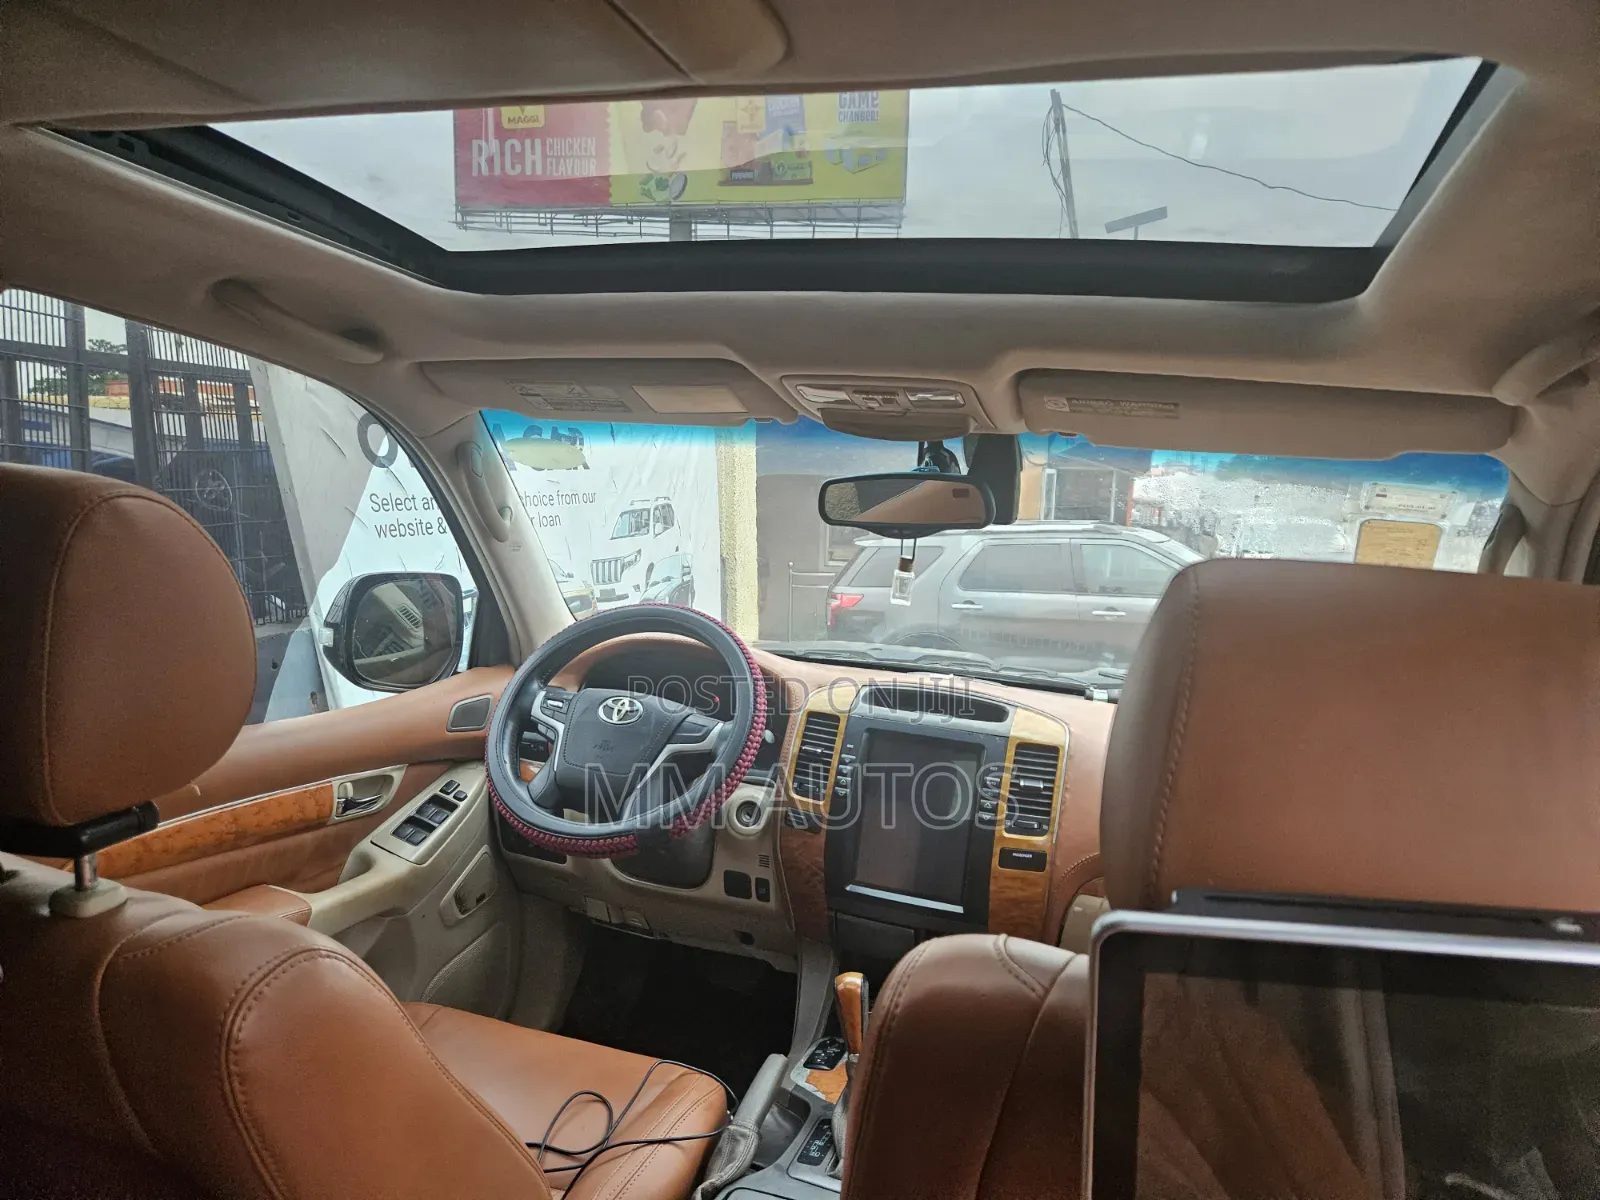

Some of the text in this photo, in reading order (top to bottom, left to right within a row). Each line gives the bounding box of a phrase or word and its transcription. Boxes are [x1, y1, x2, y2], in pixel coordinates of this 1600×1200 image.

[507, 115, 541, 125] MAGGI
[546, 136, 596, 156] CHICKEN
[472, 138, 542, 177] RICH
[547, 157, 597, 176] FLAVOUR
[369, 492, 418, 512] Select
[556, 489, 581, 506] from
[582, 492, 597, 504] our
[374, 518, 434, 539] website
[437, 516, 448, 534] &
[538, 511, 562, 528] loan
